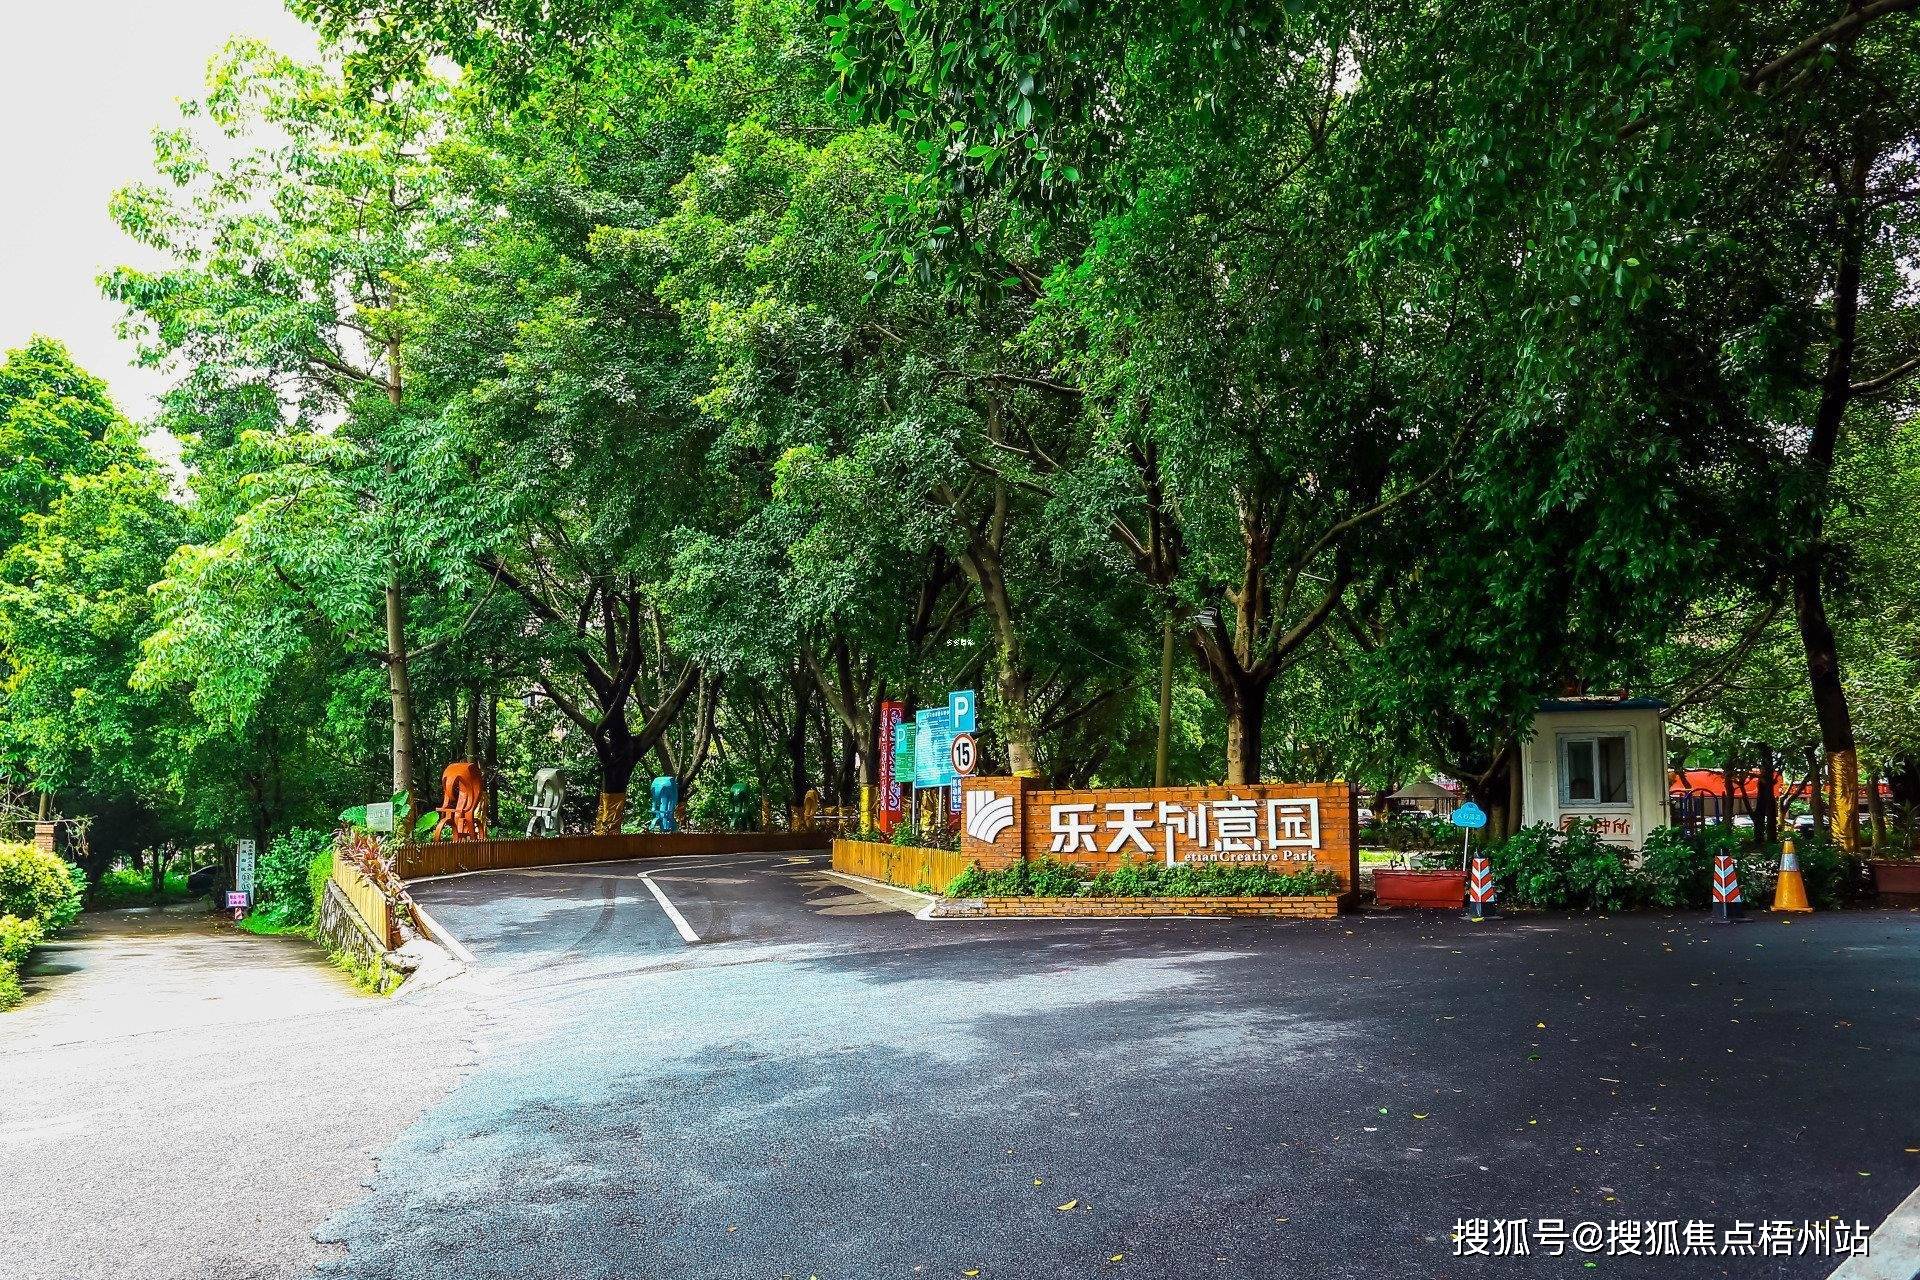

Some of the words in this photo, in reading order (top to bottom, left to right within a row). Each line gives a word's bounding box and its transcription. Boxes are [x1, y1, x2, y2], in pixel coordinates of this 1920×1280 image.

[954, 697, 968, 728] P
[956, 742, 970, 766] 15
[1050, 796, 1321, 866] 乐天创意园
[1283, 850, 1317, 862] Park
